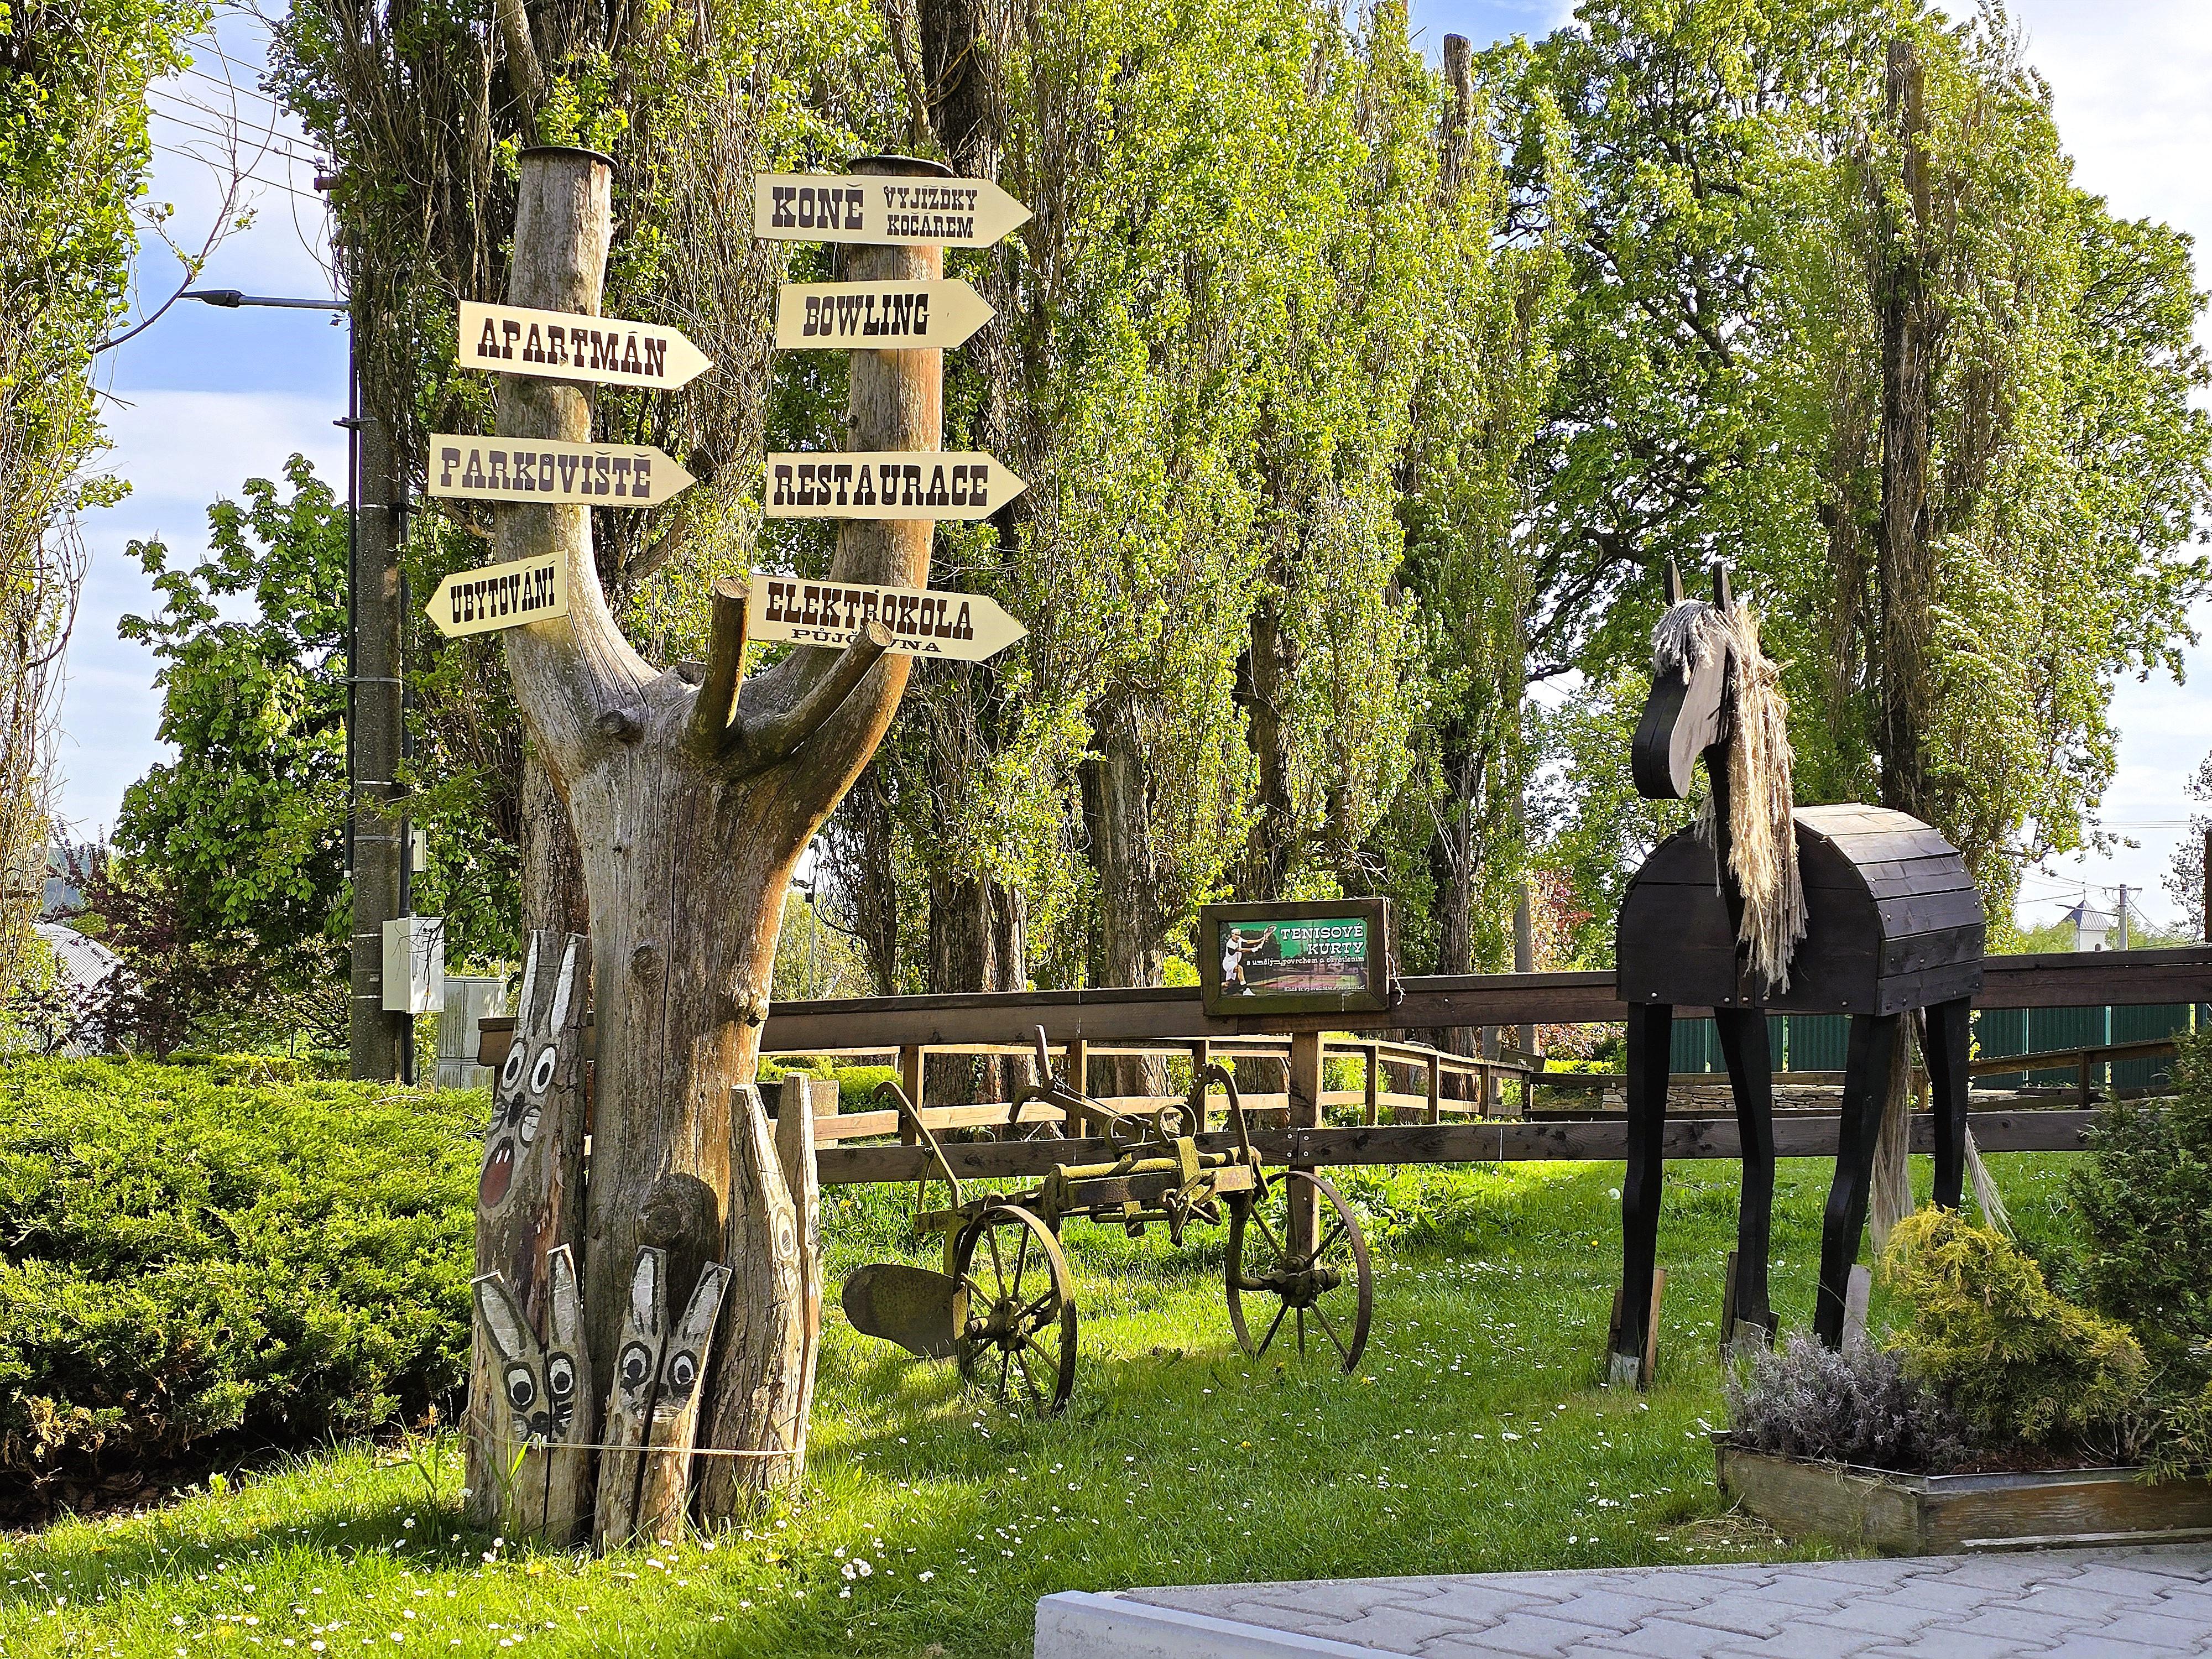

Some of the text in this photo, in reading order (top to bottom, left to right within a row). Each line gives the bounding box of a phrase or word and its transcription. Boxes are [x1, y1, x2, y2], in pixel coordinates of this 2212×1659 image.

[772, 183, 863, 229] KONĚ
[883, 185, 978, 211] VYJÍŽĎKY
[886, 212, 973, 238] KOČÁREM
[803, 294, 930, 337] BOWLING
[477, 318, 667, 377] APARTMÁN
[440, 447, 651, 498] PARKOVIŠTĚ
[774, 465, 988, 507] RESTAURACE
[450, 560, 555, 624] UBYTOVÁNÍ
[766, 582, 974, 640] ELEKTROKOLA
[1280, 922, 1364, 940] TENISOVÉ
[1307, 942, 1364, 956] KURTY
